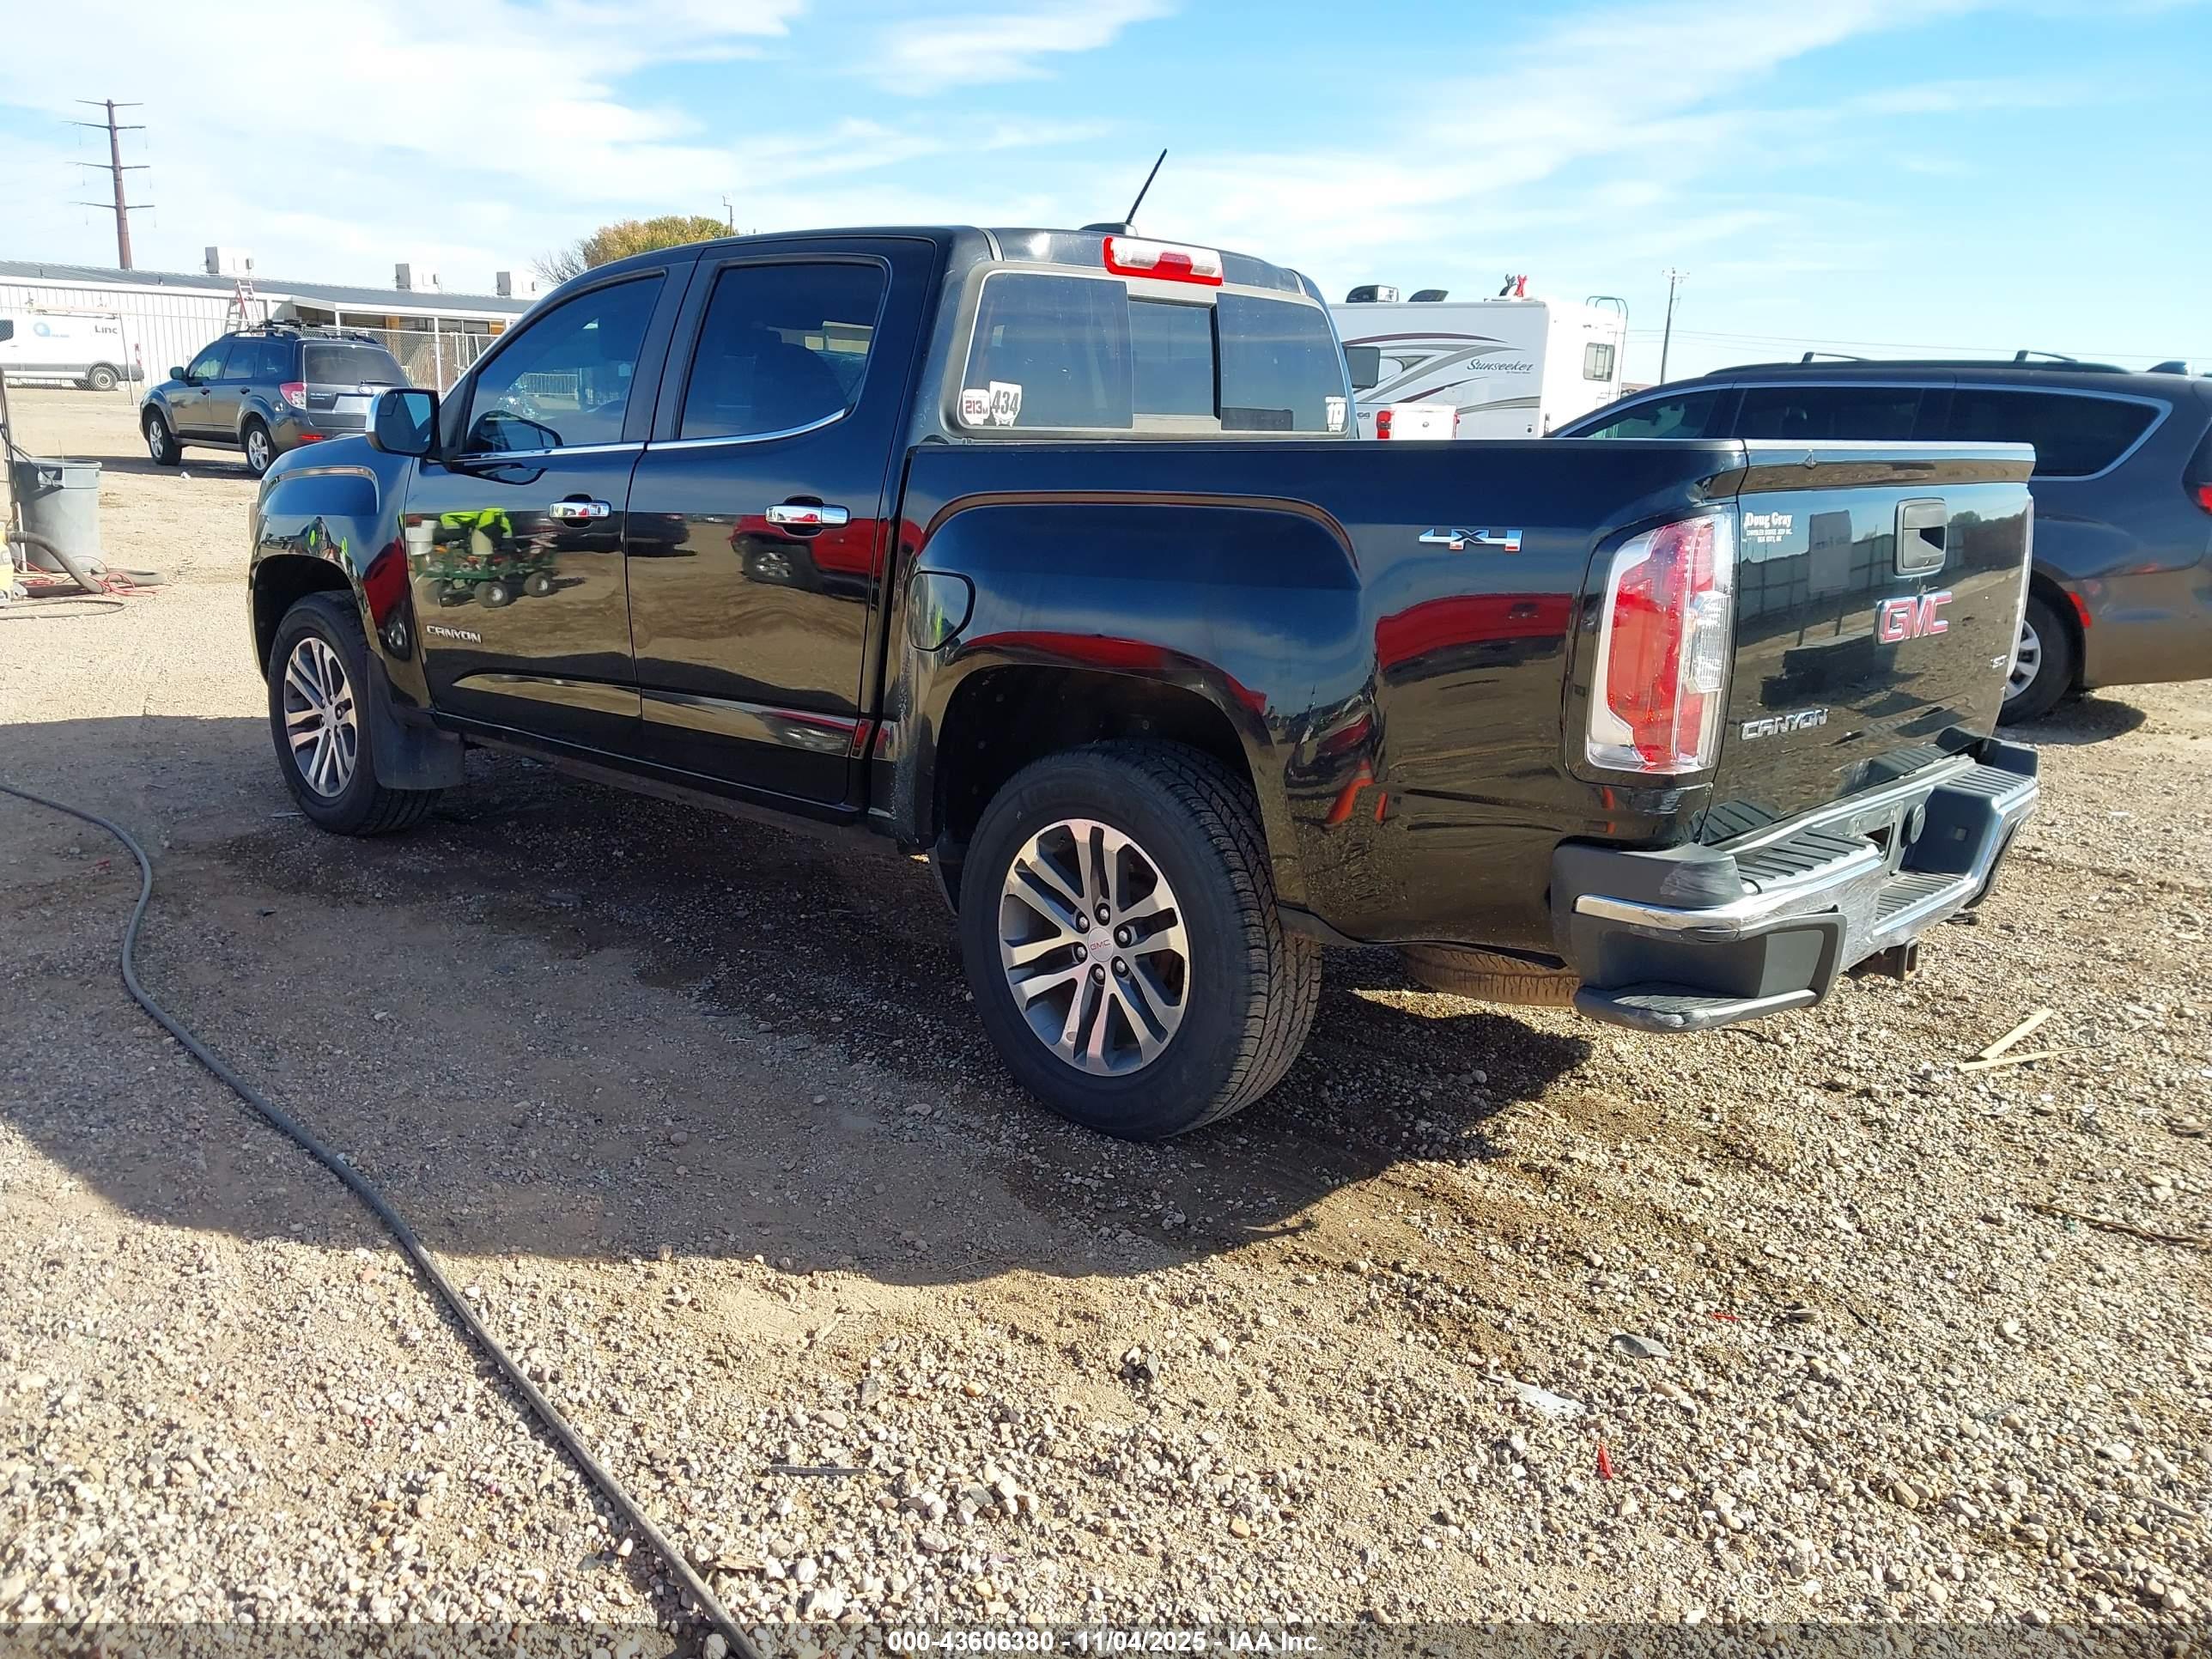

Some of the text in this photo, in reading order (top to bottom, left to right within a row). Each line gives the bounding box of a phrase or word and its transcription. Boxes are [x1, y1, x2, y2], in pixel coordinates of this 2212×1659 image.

[1467, 358, 1534, 371] Sunseeker
[991, 390, 1019, 416] 434
[1743, 512, 1793, 529] Doug Gray
[1419, 528, 1523, 551] 4X4
[1874, 591, 1953, 645] GMC
[426, 624, 482, 643] CANYON
[1740, 708, 1829, 741] CANYON
[1090, 939, 1111, 951] GMC
